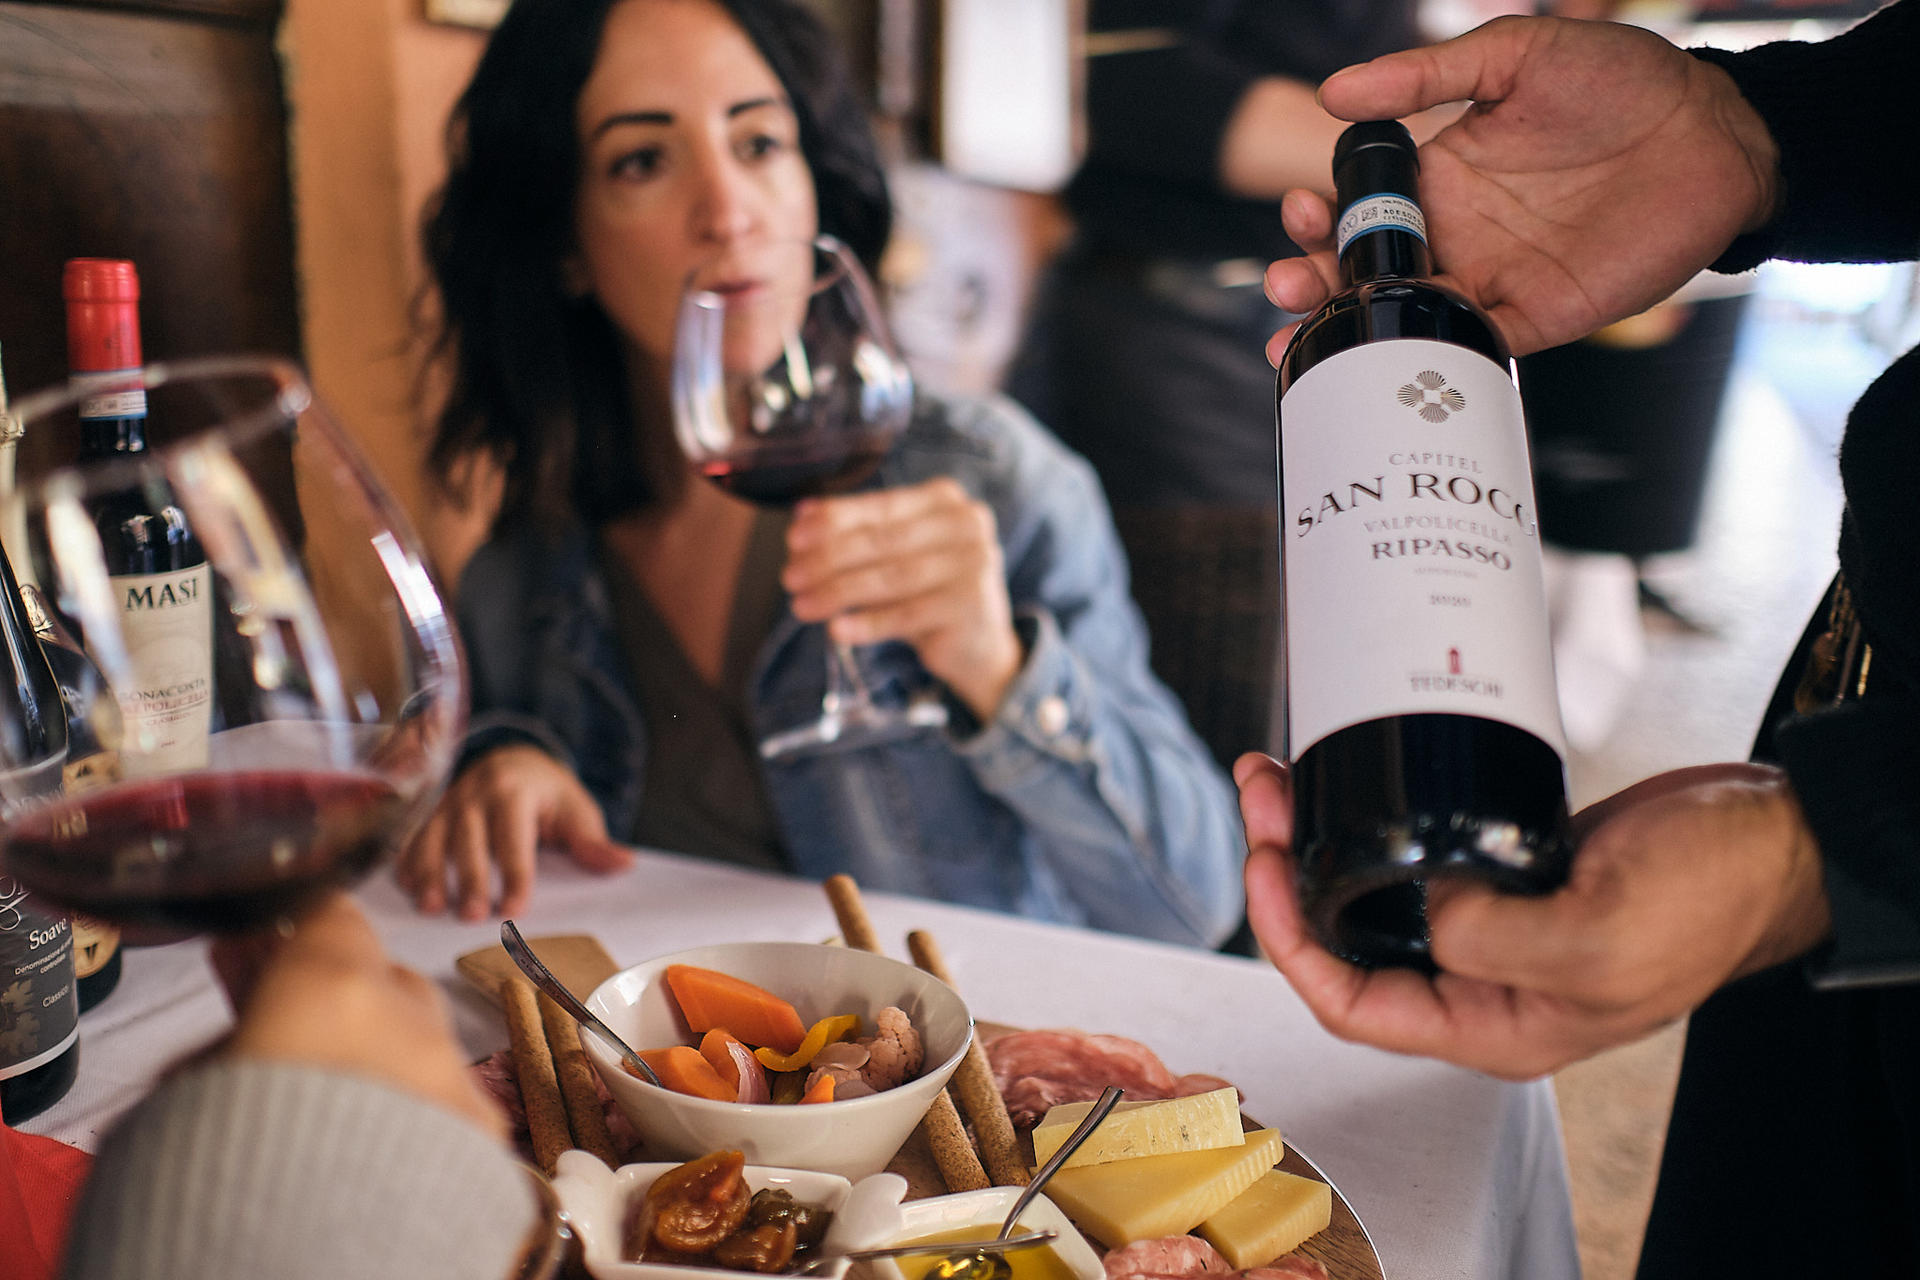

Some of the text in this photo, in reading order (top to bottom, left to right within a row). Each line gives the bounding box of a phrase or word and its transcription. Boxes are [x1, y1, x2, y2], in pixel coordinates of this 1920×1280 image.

[1388, 452, 1482, 474] CAPITEL
[1296, 473, 1537, 539] SAN ROCC
[1371, 538, 1512, 571] RIPASSO
[125, 578, 198, 612] MASI
[28, 918, 68, 951] Soave
[42, 985, 70, 1008] Classico
